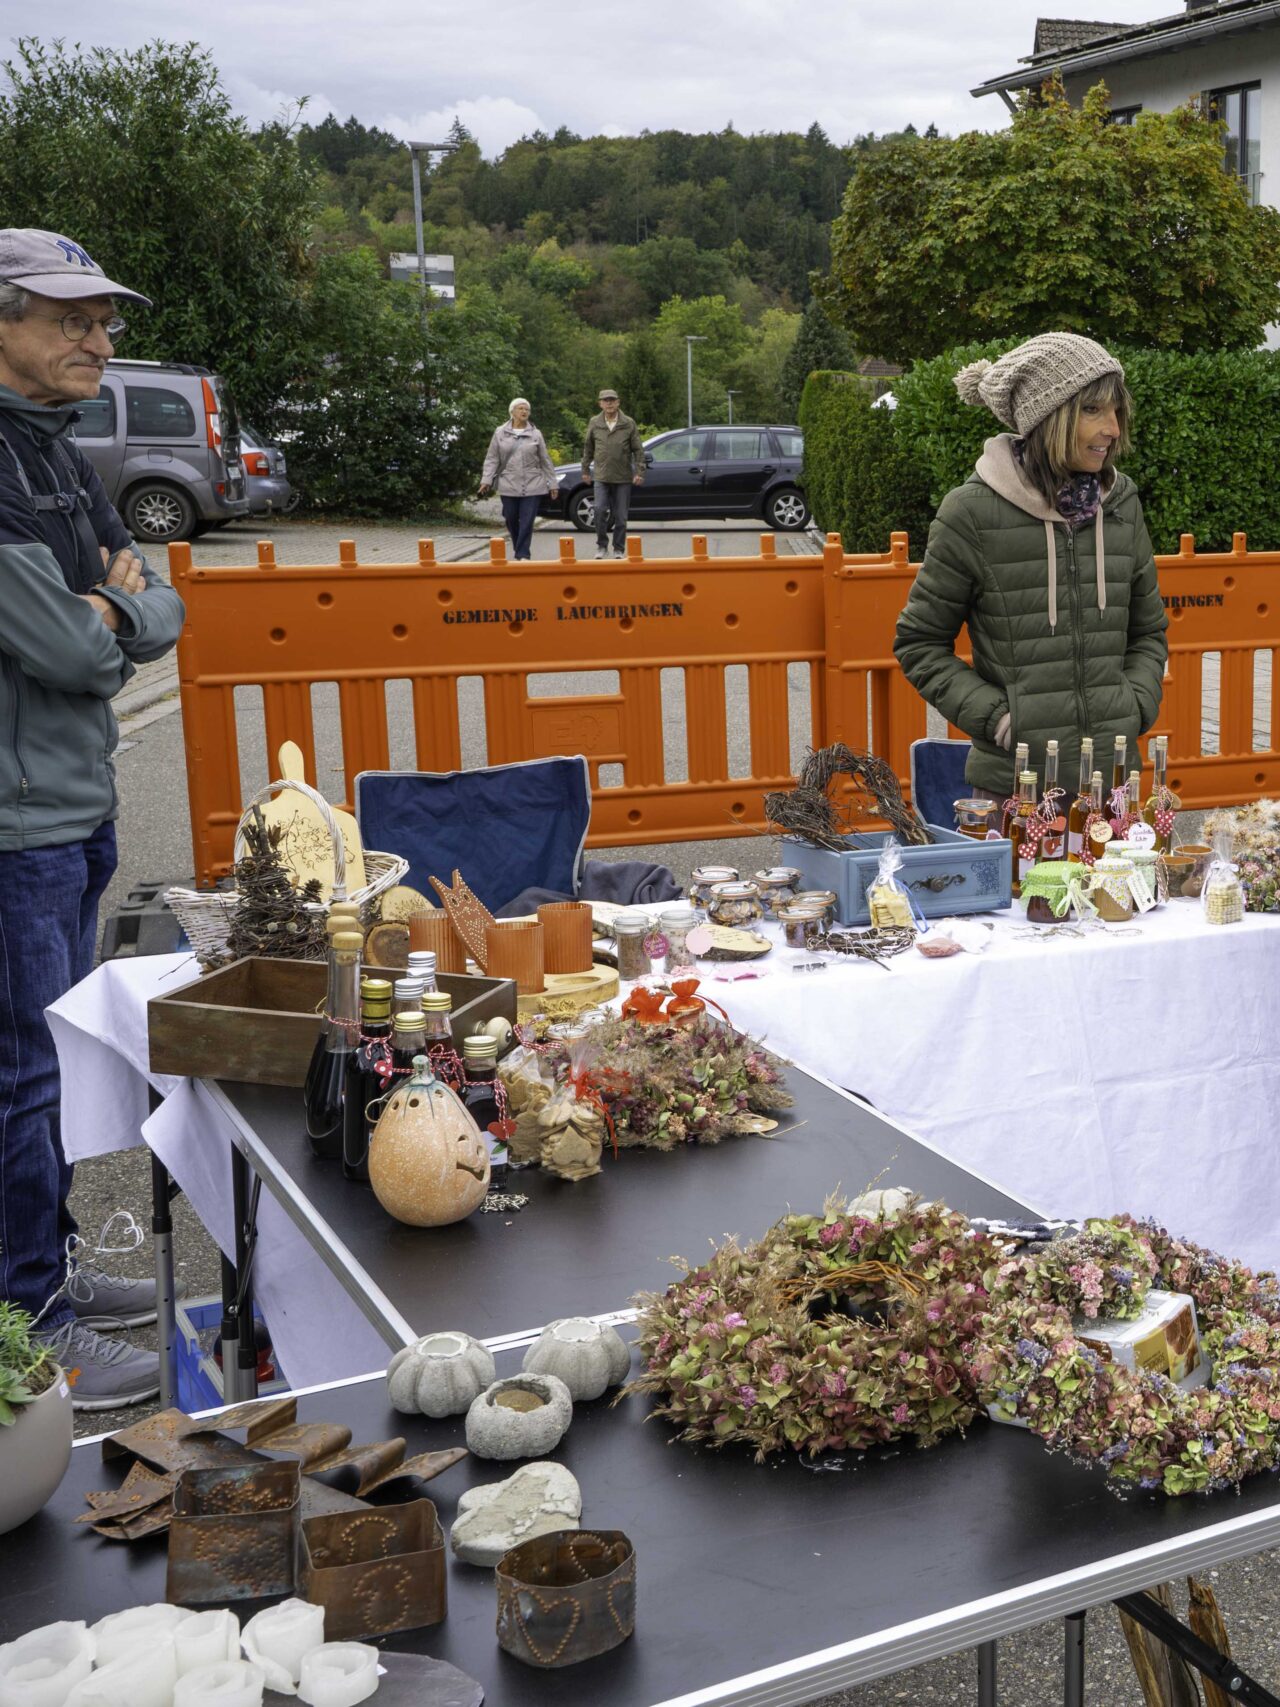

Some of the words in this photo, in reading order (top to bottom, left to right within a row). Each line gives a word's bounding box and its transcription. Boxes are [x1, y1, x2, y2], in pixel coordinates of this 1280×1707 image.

[1160, 594, 1224, 609] HRINGEN
[442, 608, 539, 625] GEMEINDE
[556, 602, 684, 621] LAUCHRINGEN
